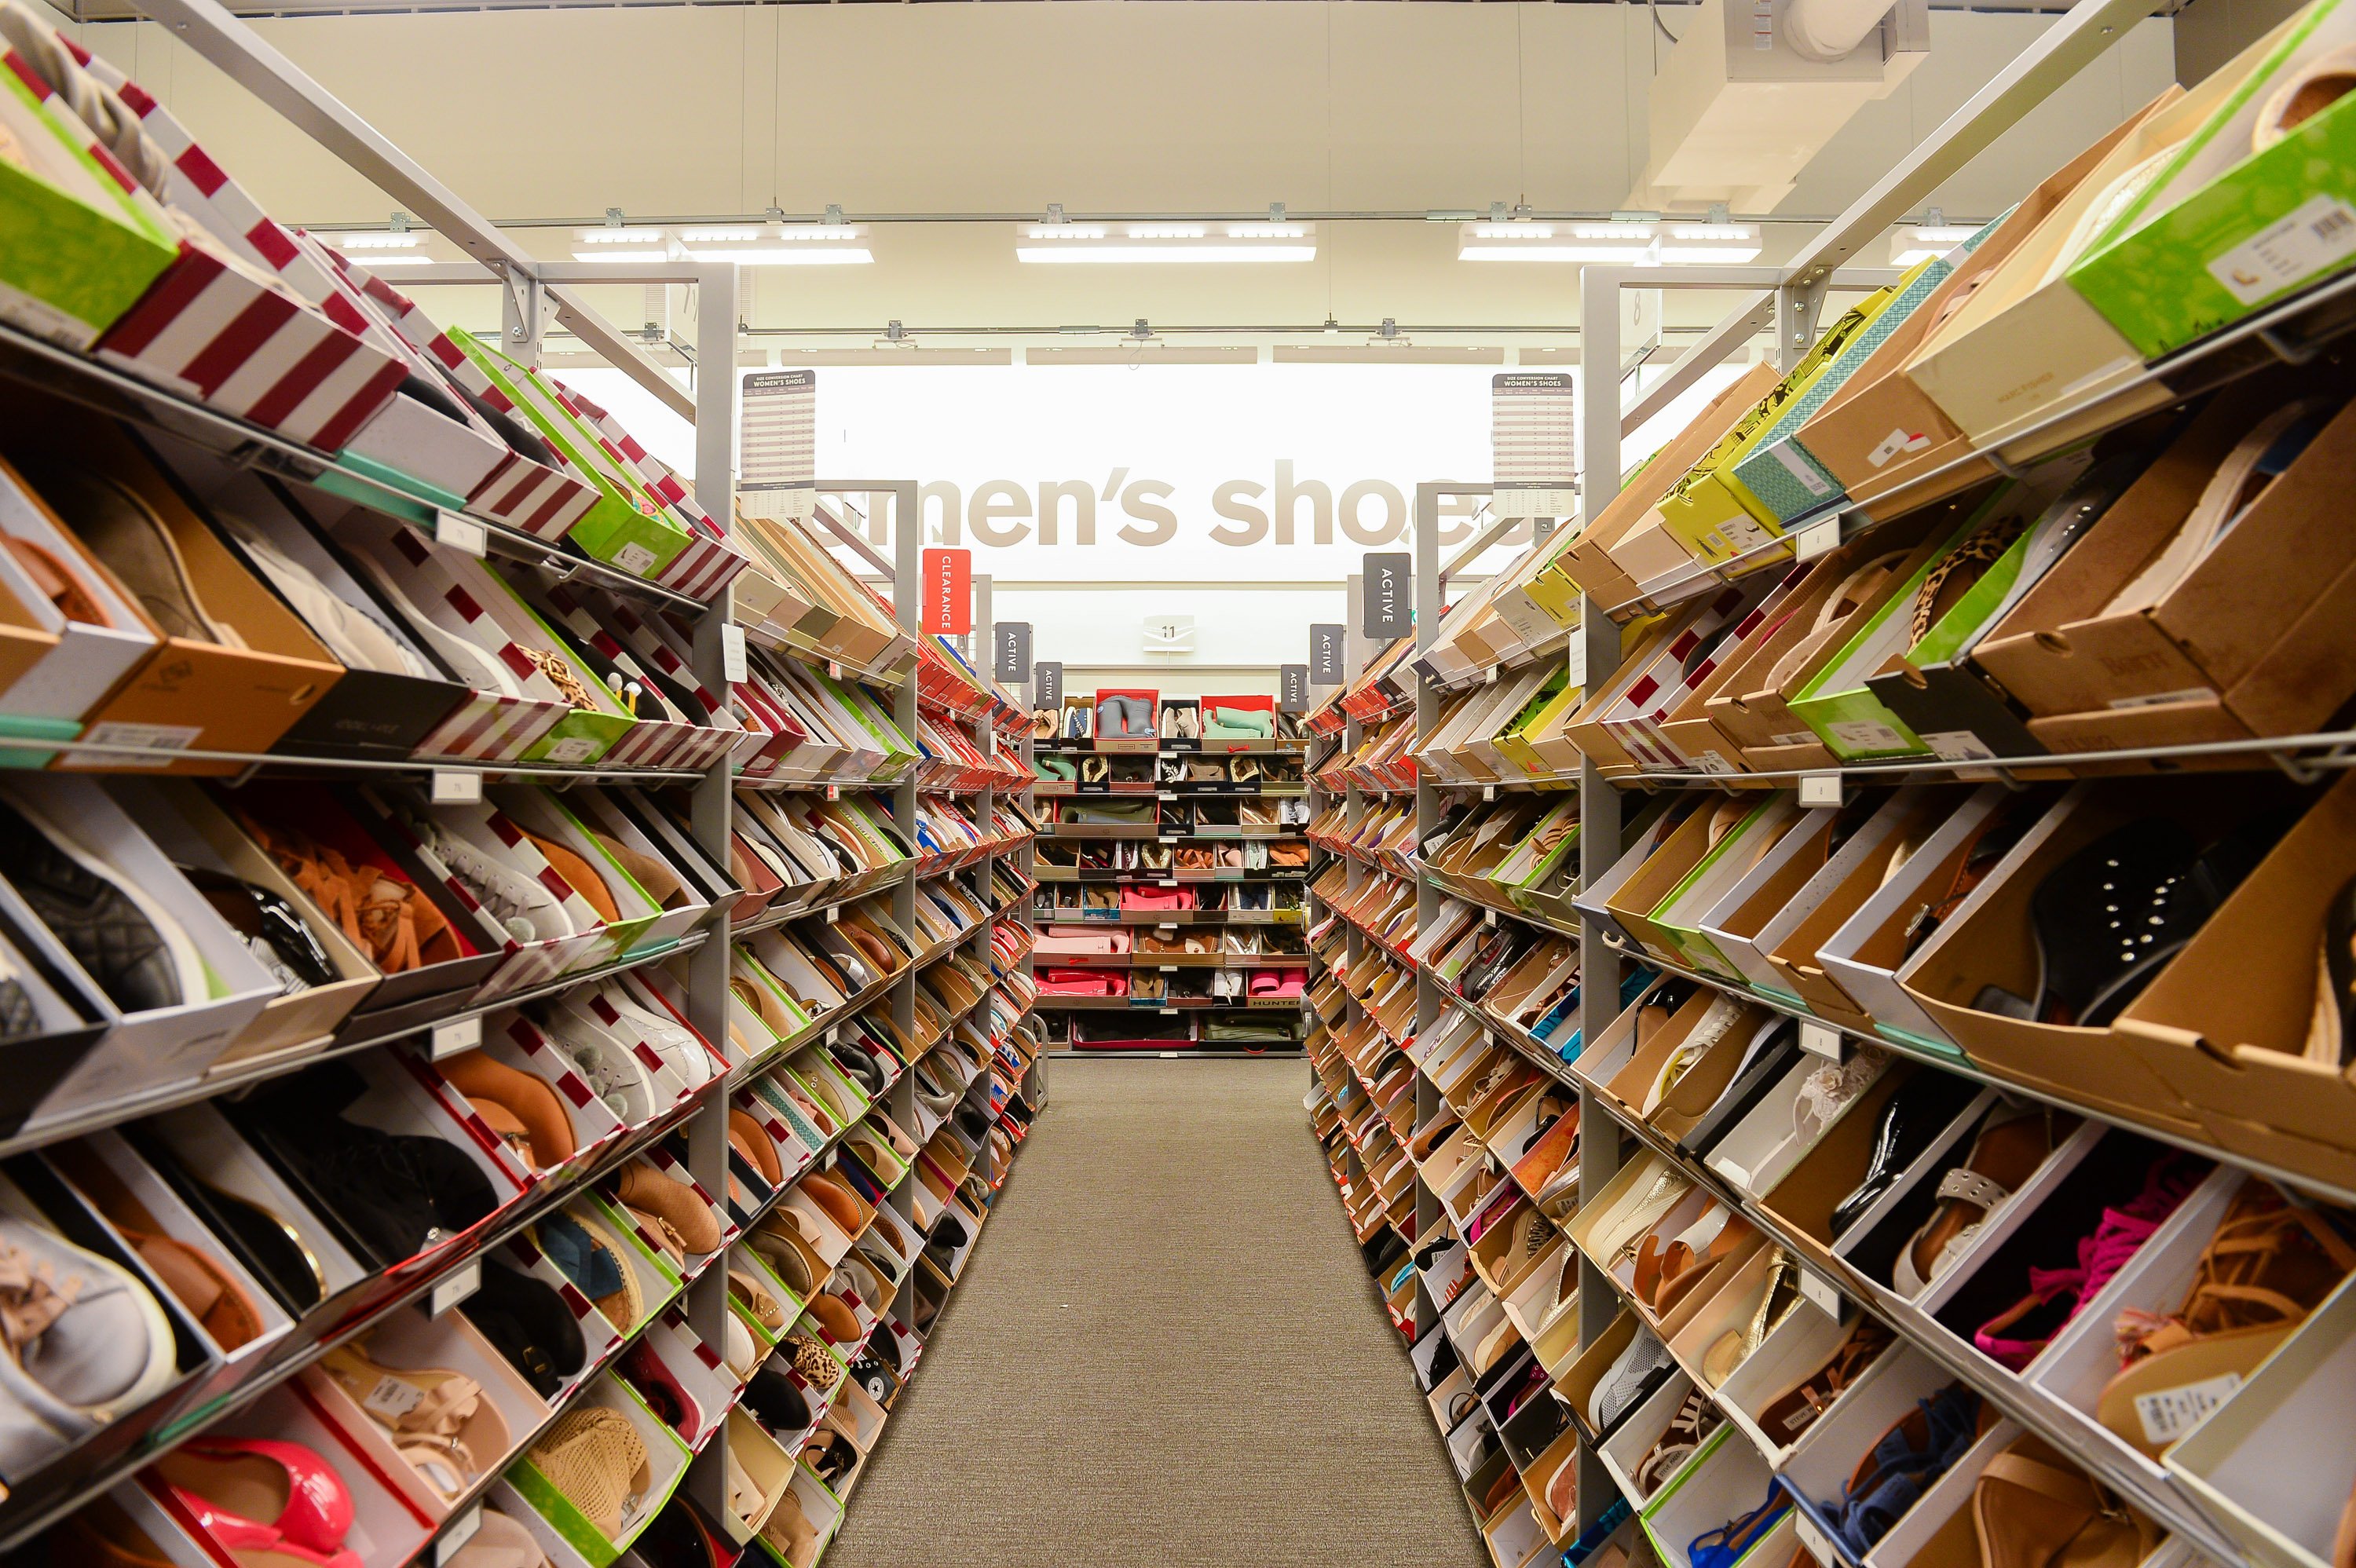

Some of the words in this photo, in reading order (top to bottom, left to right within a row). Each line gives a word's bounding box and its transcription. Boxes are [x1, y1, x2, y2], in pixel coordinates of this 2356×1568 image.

[942, 556, 952, 629] CLEARANCE
[1381, 568, 1393, 623] ACTIVE
[1162, 625, 1175, 638] 11
[1008, 632, 1017, 671] ACTIVE
[1322, 634, 1331, 674] ACTIVE
[1790, 1412, 1806, 1424] STEVE
[1659, 1464, 1671, 1478] STEVE
